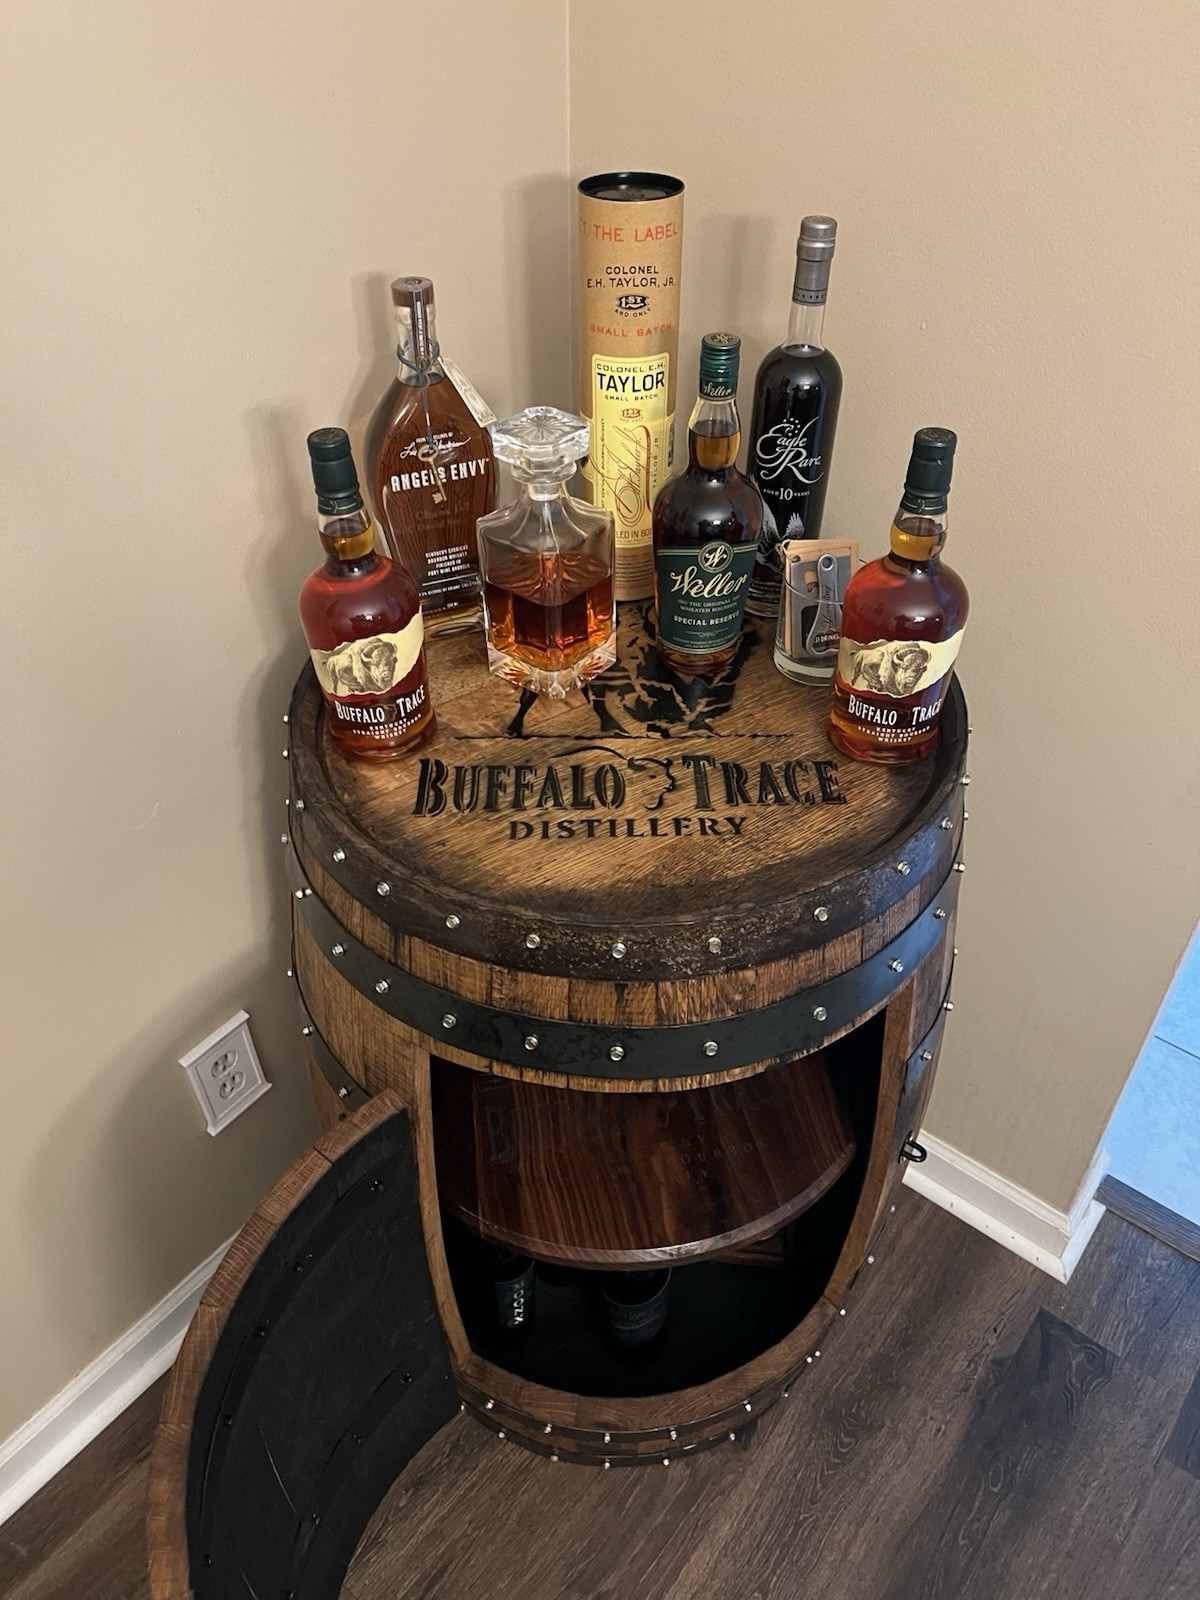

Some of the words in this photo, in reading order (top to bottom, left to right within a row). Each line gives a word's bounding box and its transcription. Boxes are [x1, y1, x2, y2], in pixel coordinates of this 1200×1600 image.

[594, 225, 624, 242] THE
[635, 222, 678, 243] LABEL
[606, 265, 659, 275] COLONEL
[587, 278, 606, 288] E.H.
[609, 277, 660, 289] TAYLOR,
[614, 309, 629, 318] AND
[633, 308, 652, 318] ONLY
[590, 325, 628, 337] SMALL
[637, 323, 672, 336] BATCH
[597, 364, 644, 372] COLONEL
[649, 363, 665, 371] E.H.
[597, 371, 664, 392] TAYLOR
[756, 416, 819, 467] Eagle
[450, 459, 487, 480] ENVY
[760, 447, 824, 484] Rare
[763, 488, 779, 496] AGED
[779, 487, 793, 501] 10
[703, 545, 727, 568] W
[669, 565, 748, 598] Weller
[674, 615, 707, 626] SPECIAL
[710, 610, 740, 625] RESERVE
[334, 701, 385, 723] BUFFALO
[396, 685, 425, 717] TRACE
[848, 694, 897, 726] BUFFALO
[912, 698, 943, 725] TRACE
[412, 758, 626, 817] BUFFALO
[682, 754, 847, 812] TRACE
[509, 816, 749, 841] DISTILLERY
